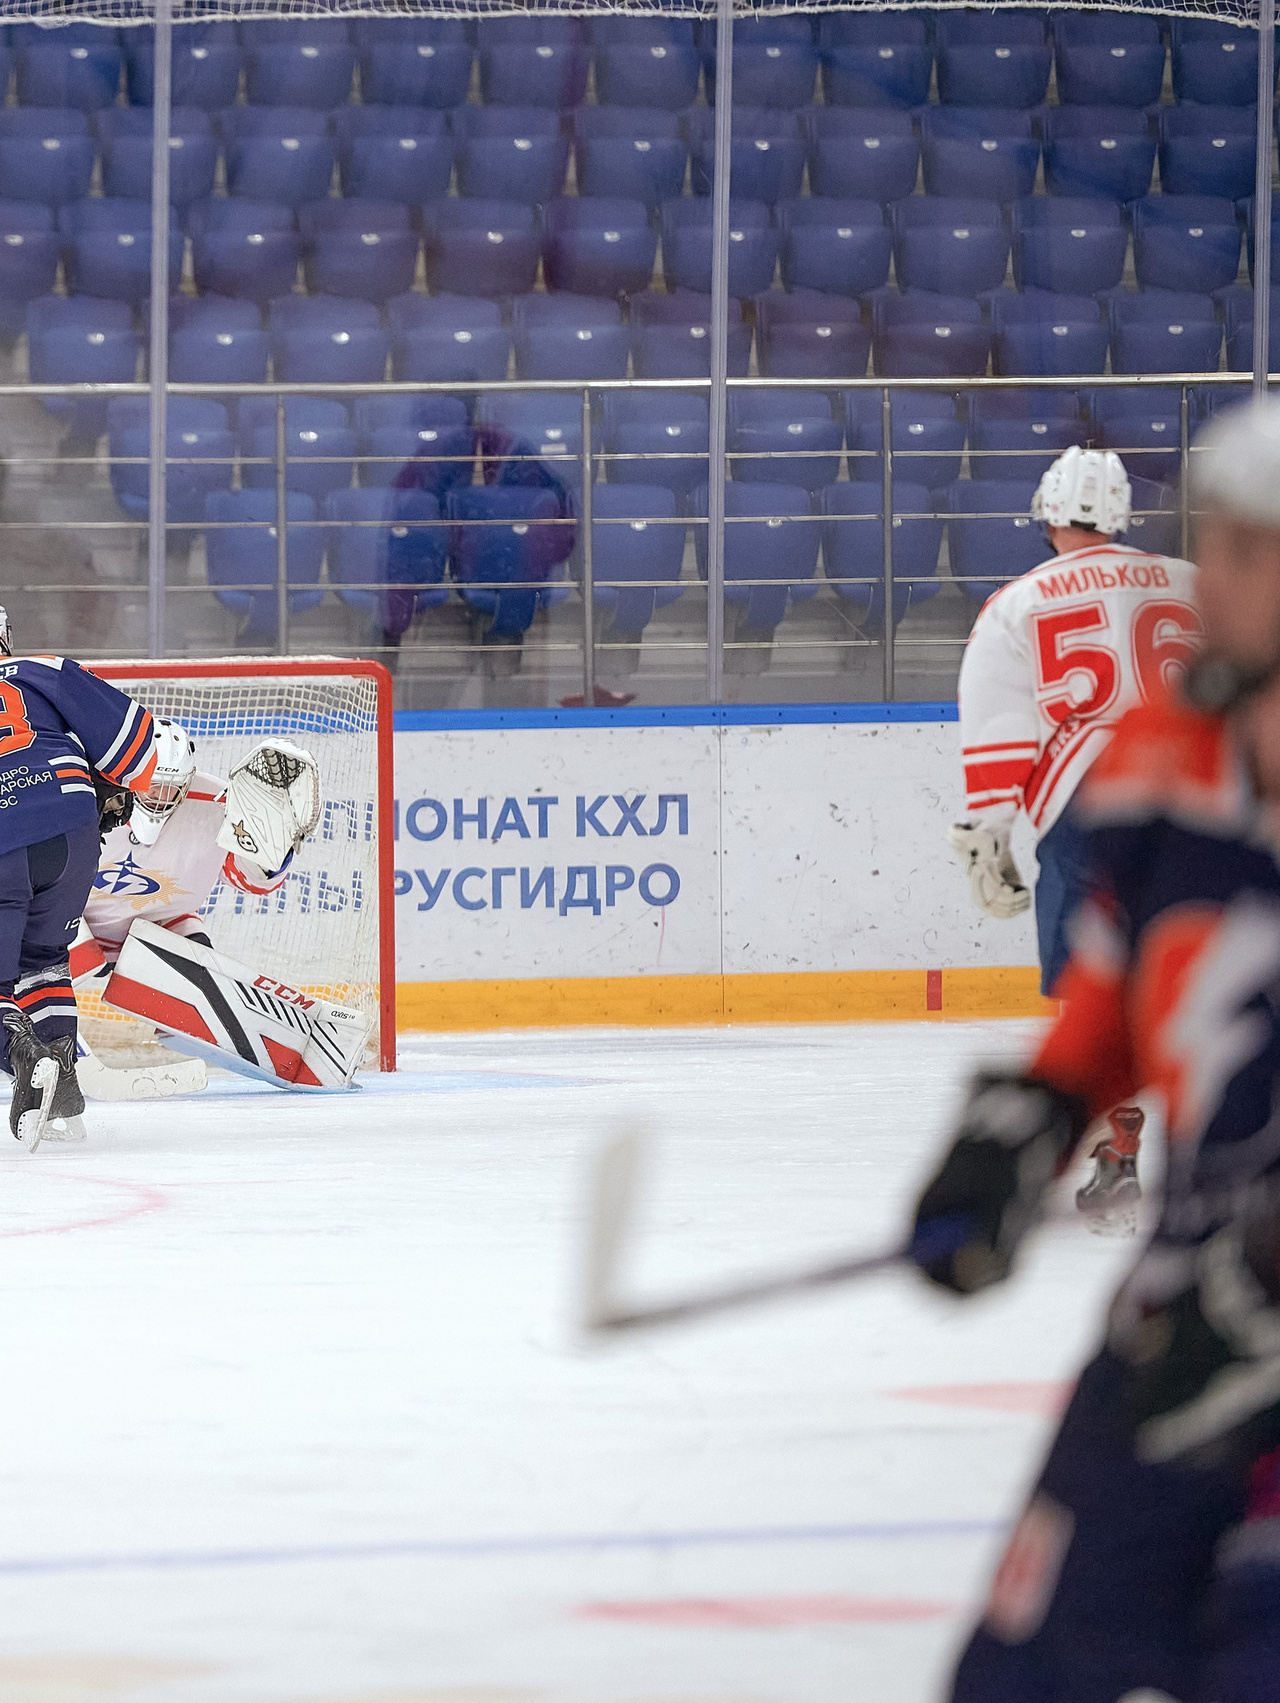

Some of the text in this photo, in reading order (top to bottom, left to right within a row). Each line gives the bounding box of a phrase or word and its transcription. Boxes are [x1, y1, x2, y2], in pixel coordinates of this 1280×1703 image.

[1036, 564, 1170, 599] МИЛЬКОВ
[1029, 598, 1209, 728] 56
[576, 793, 689, 838] КХЛ
[253, 974, 316, 1011] CCM
